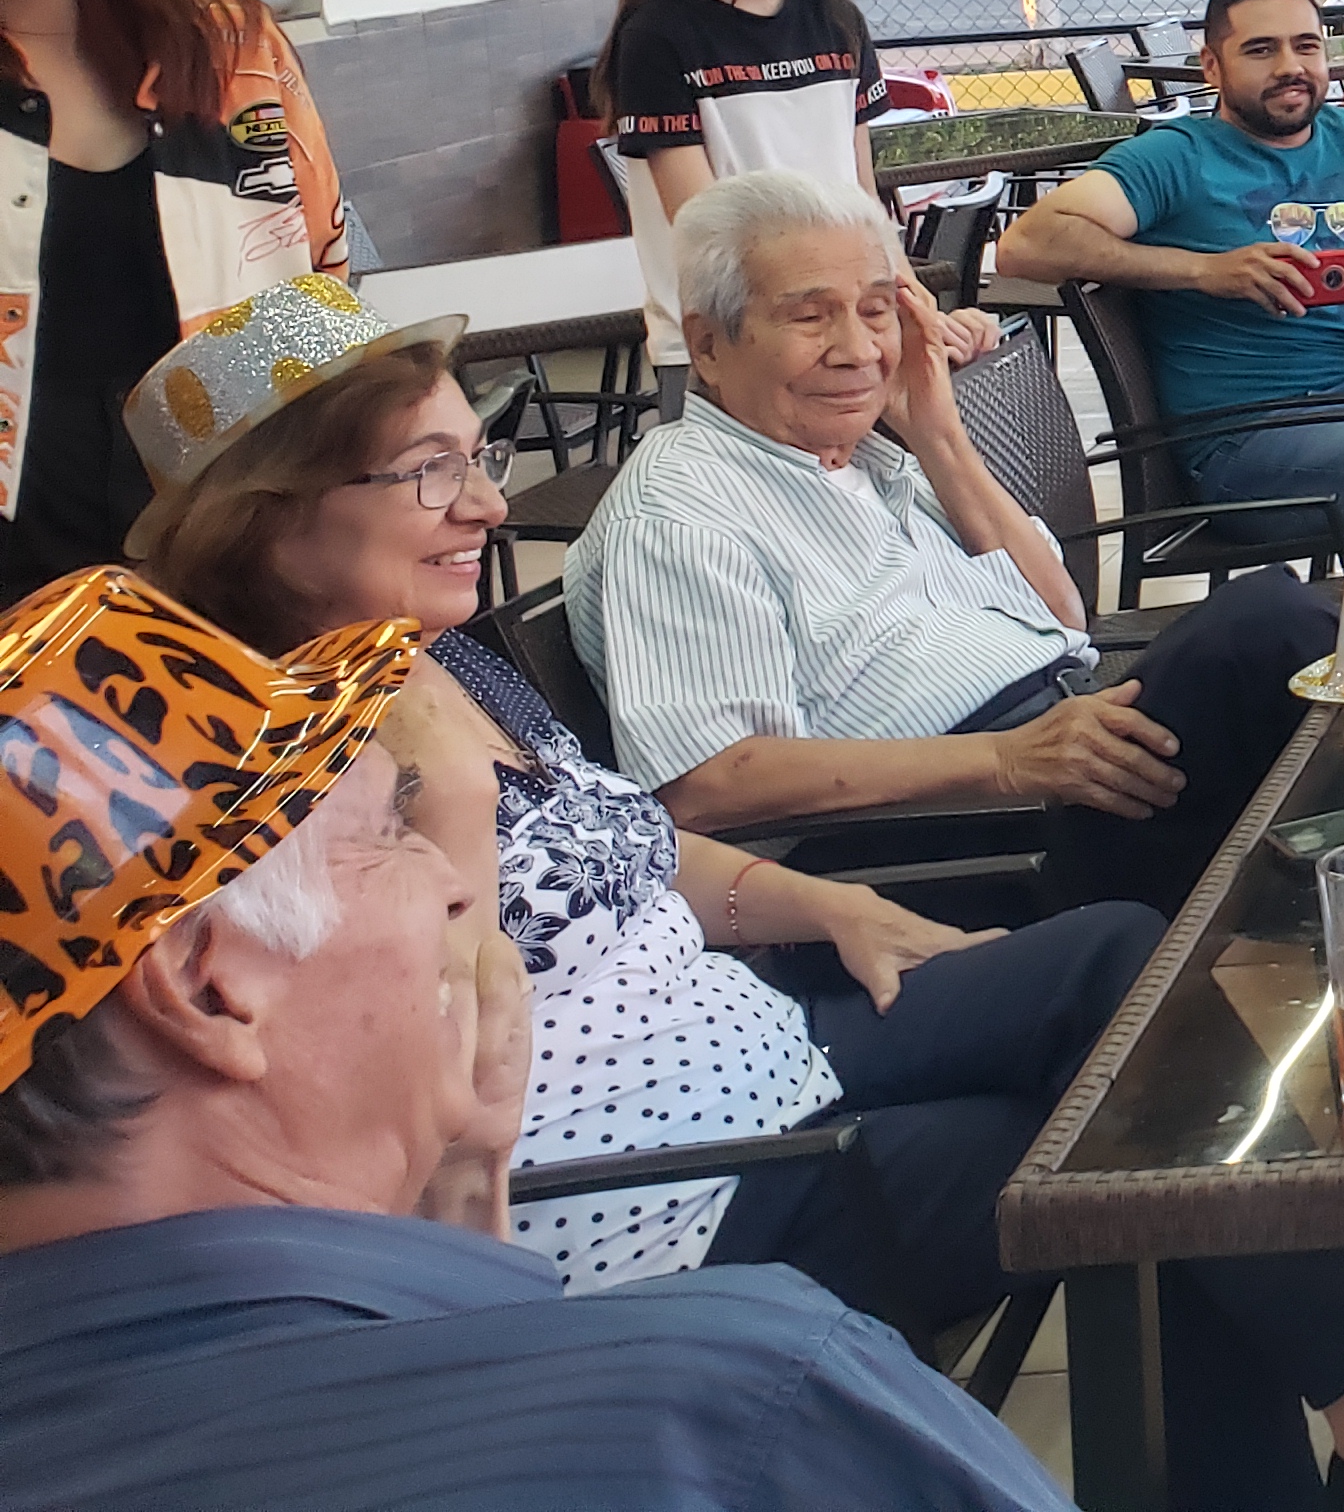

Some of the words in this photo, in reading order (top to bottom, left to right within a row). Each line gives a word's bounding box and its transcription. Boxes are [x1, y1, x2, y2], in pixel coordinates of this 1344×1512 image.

[761, 61, 792, 81] KEEP
[791, 57, 816, 77] YOU
[638, 116, 659, 133] ON
[663, 114, 690, 133] THE
